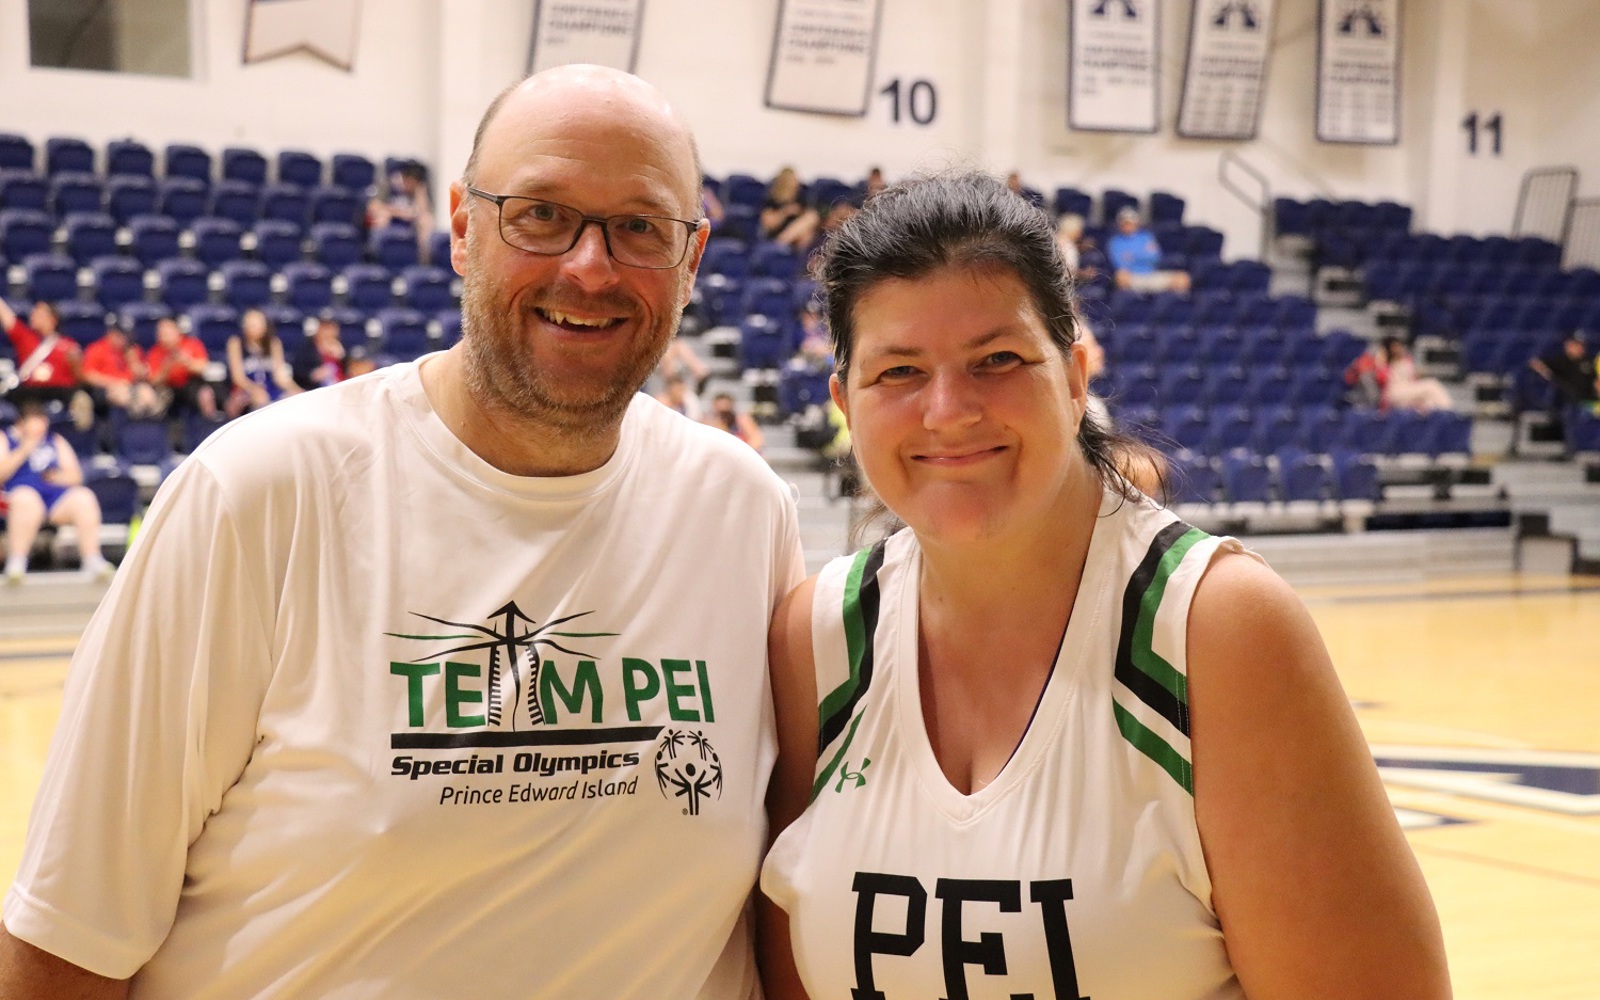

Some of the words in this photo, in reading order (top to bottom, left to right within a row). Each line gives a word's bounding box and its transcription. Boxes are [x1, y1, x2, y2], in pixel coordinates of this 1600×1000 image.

[879, 79, 936, 125] 10
[1461, 112, 1502, 154] 11
[389, 659, 604, 731] TEAM
[622, 657, 716, 723] PEI
[391, 755, 504, 780] Special
[513, 750, 640, 776] Olympics
[440, 786, 503, 805] Prince
[508, 780, 579, 803] Edward
[581, 775, 640, 799] Island
[850, 871, 1091, 1000] PEI
